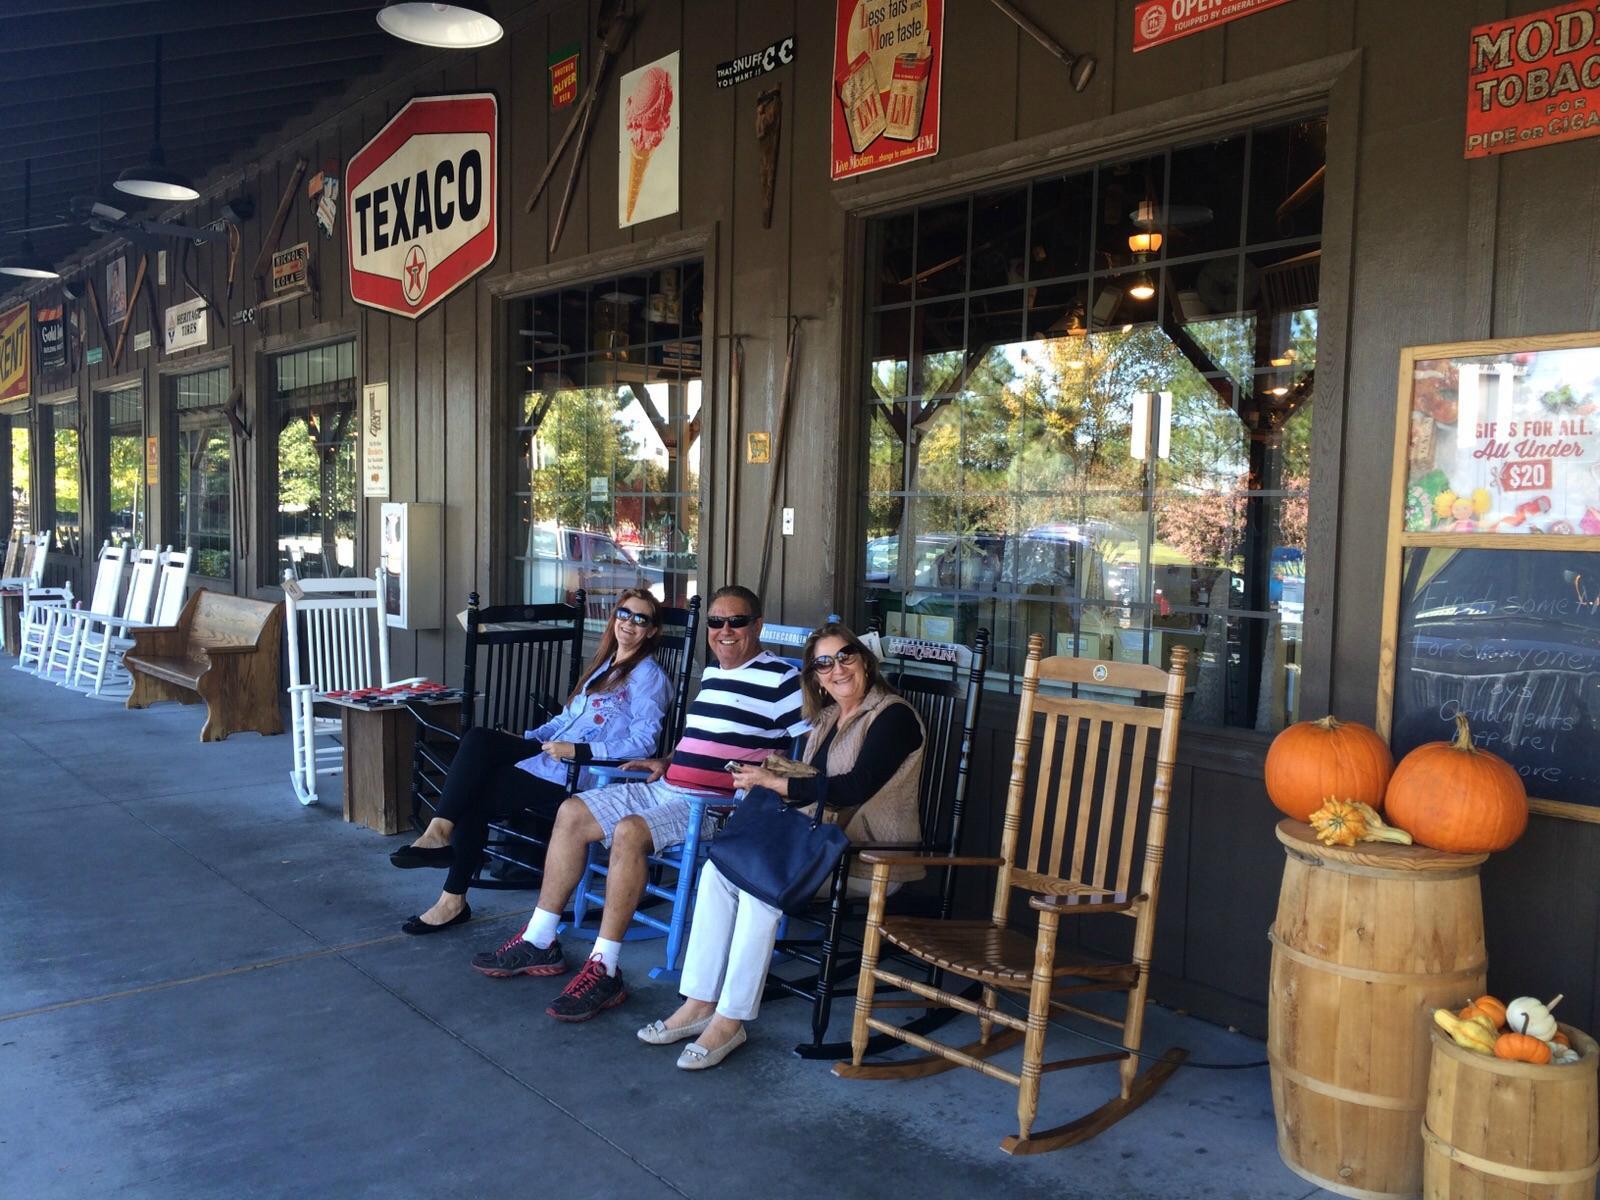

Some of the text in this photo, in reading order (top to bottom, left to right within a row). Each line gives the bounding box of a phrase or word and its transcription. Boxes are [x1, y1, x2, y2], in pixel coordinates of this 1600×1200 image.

[861, 4, 885, 30] Less
[1174, 14, 1209, 32] EQUIPPED
[1210, 9, 1220, 20] BY
[869, 17, 922, 52] More taste
[1472, 4, 1600, 75] MOD
[717, 67, 733, 78] THAT
[733, 52, 763, 73] SNUFF
[718, 77, 734, 88] YOU
[735, 69, 753, 83] WANT
[1546, 97, 1587, 116] FOR
[1467, 127, 1517, 151] PIPE
[835, 160, 849, 174] Live
[355, 149, 482, 257] TEXACO
[176, 309, 202, 326] HERITAGE
[181, 323, 197, 337] TIRES
[1475, 418, 1593, 439] GIFS FOR ALL.
[1473, 439, 1584, 460] All Under
[1509, 464, 1545, 489] $20
